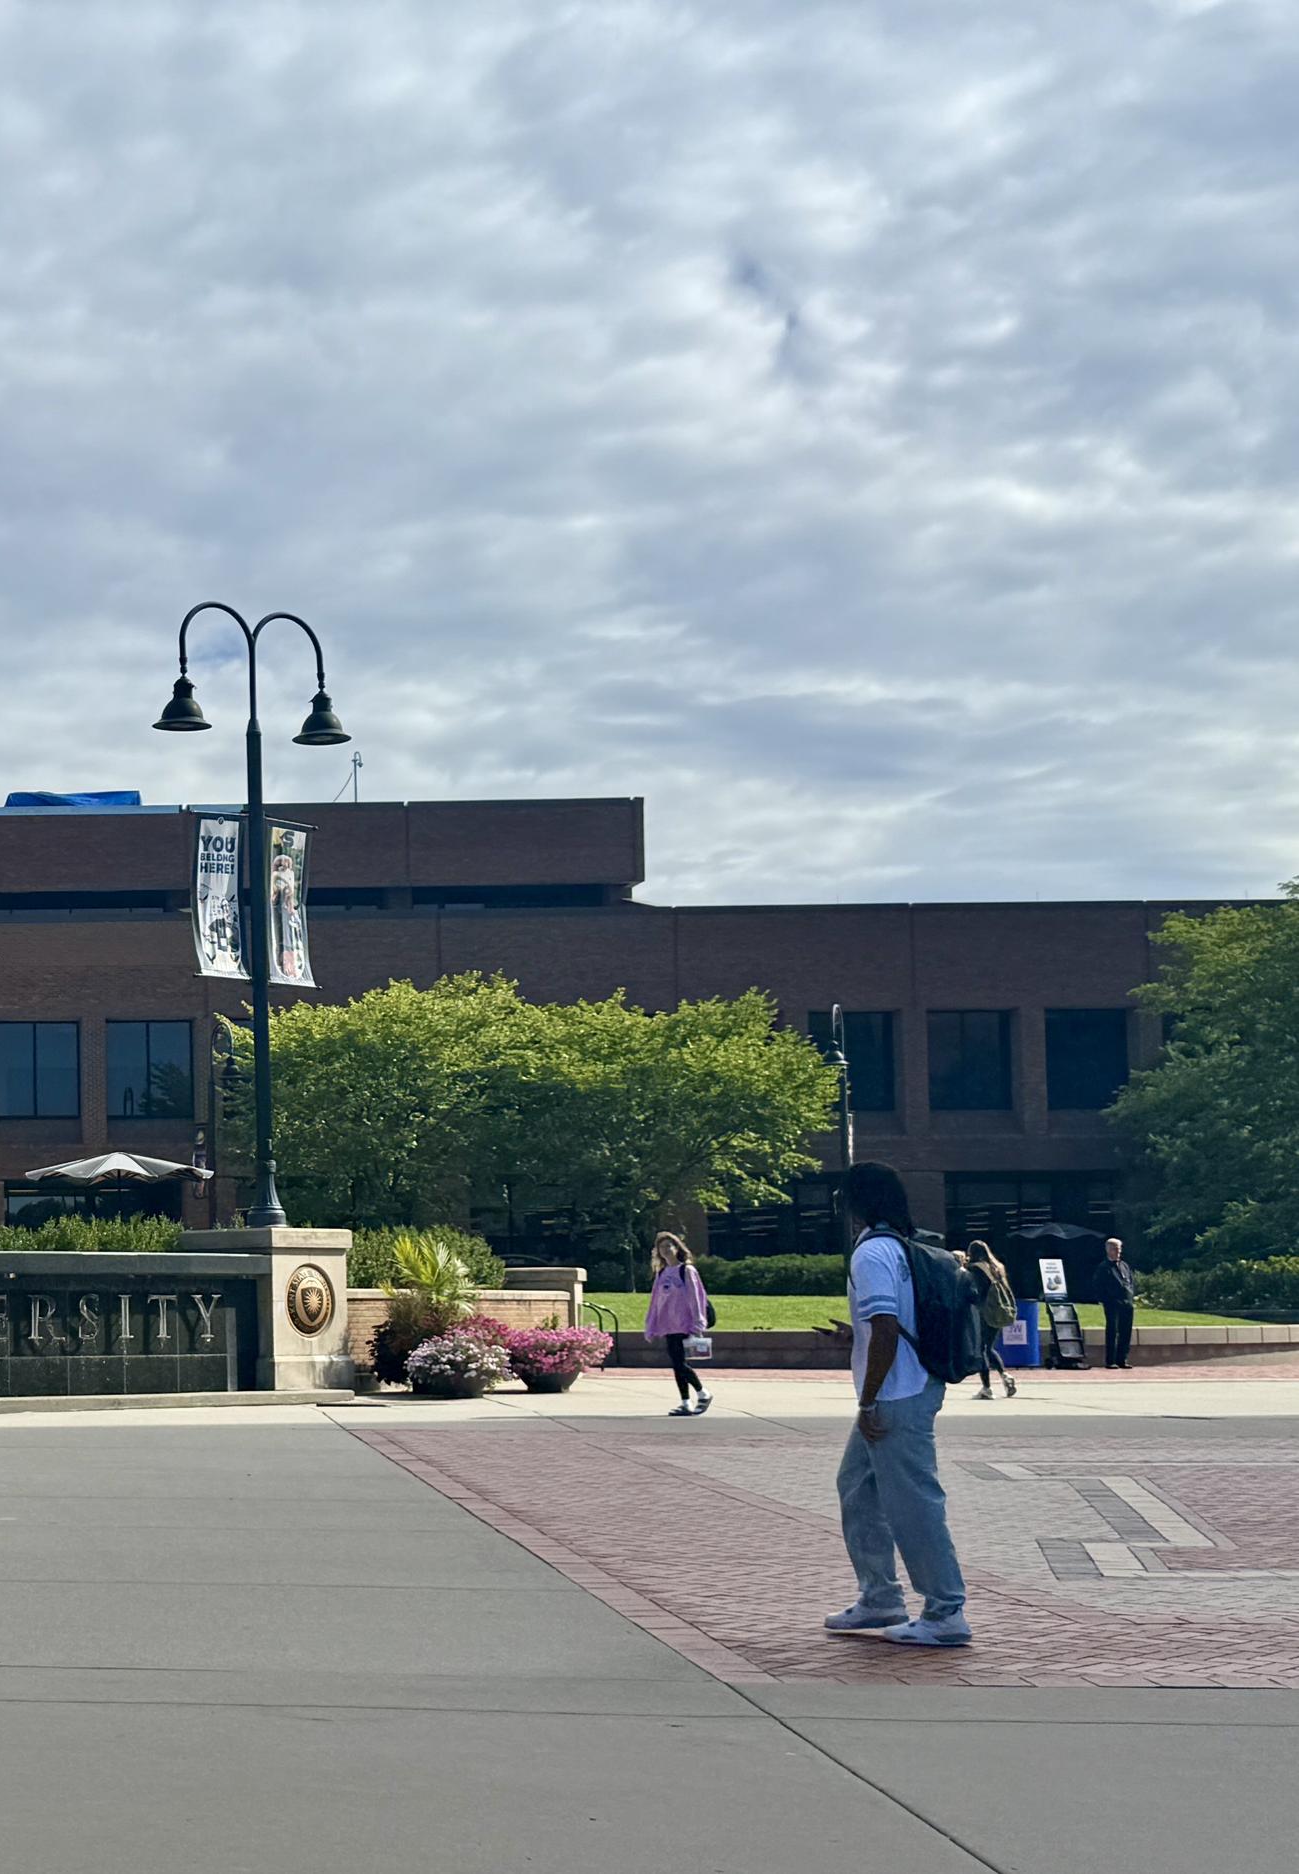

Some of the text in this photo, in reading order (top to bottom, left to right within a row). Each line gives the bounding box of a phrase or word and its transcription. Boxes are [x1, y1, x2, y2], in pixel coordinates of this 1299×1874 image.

[200, 835, 236, 853] YOU
[200, 853, 235, 863] BELONG
[200, 862, 235, 875] HERE!
